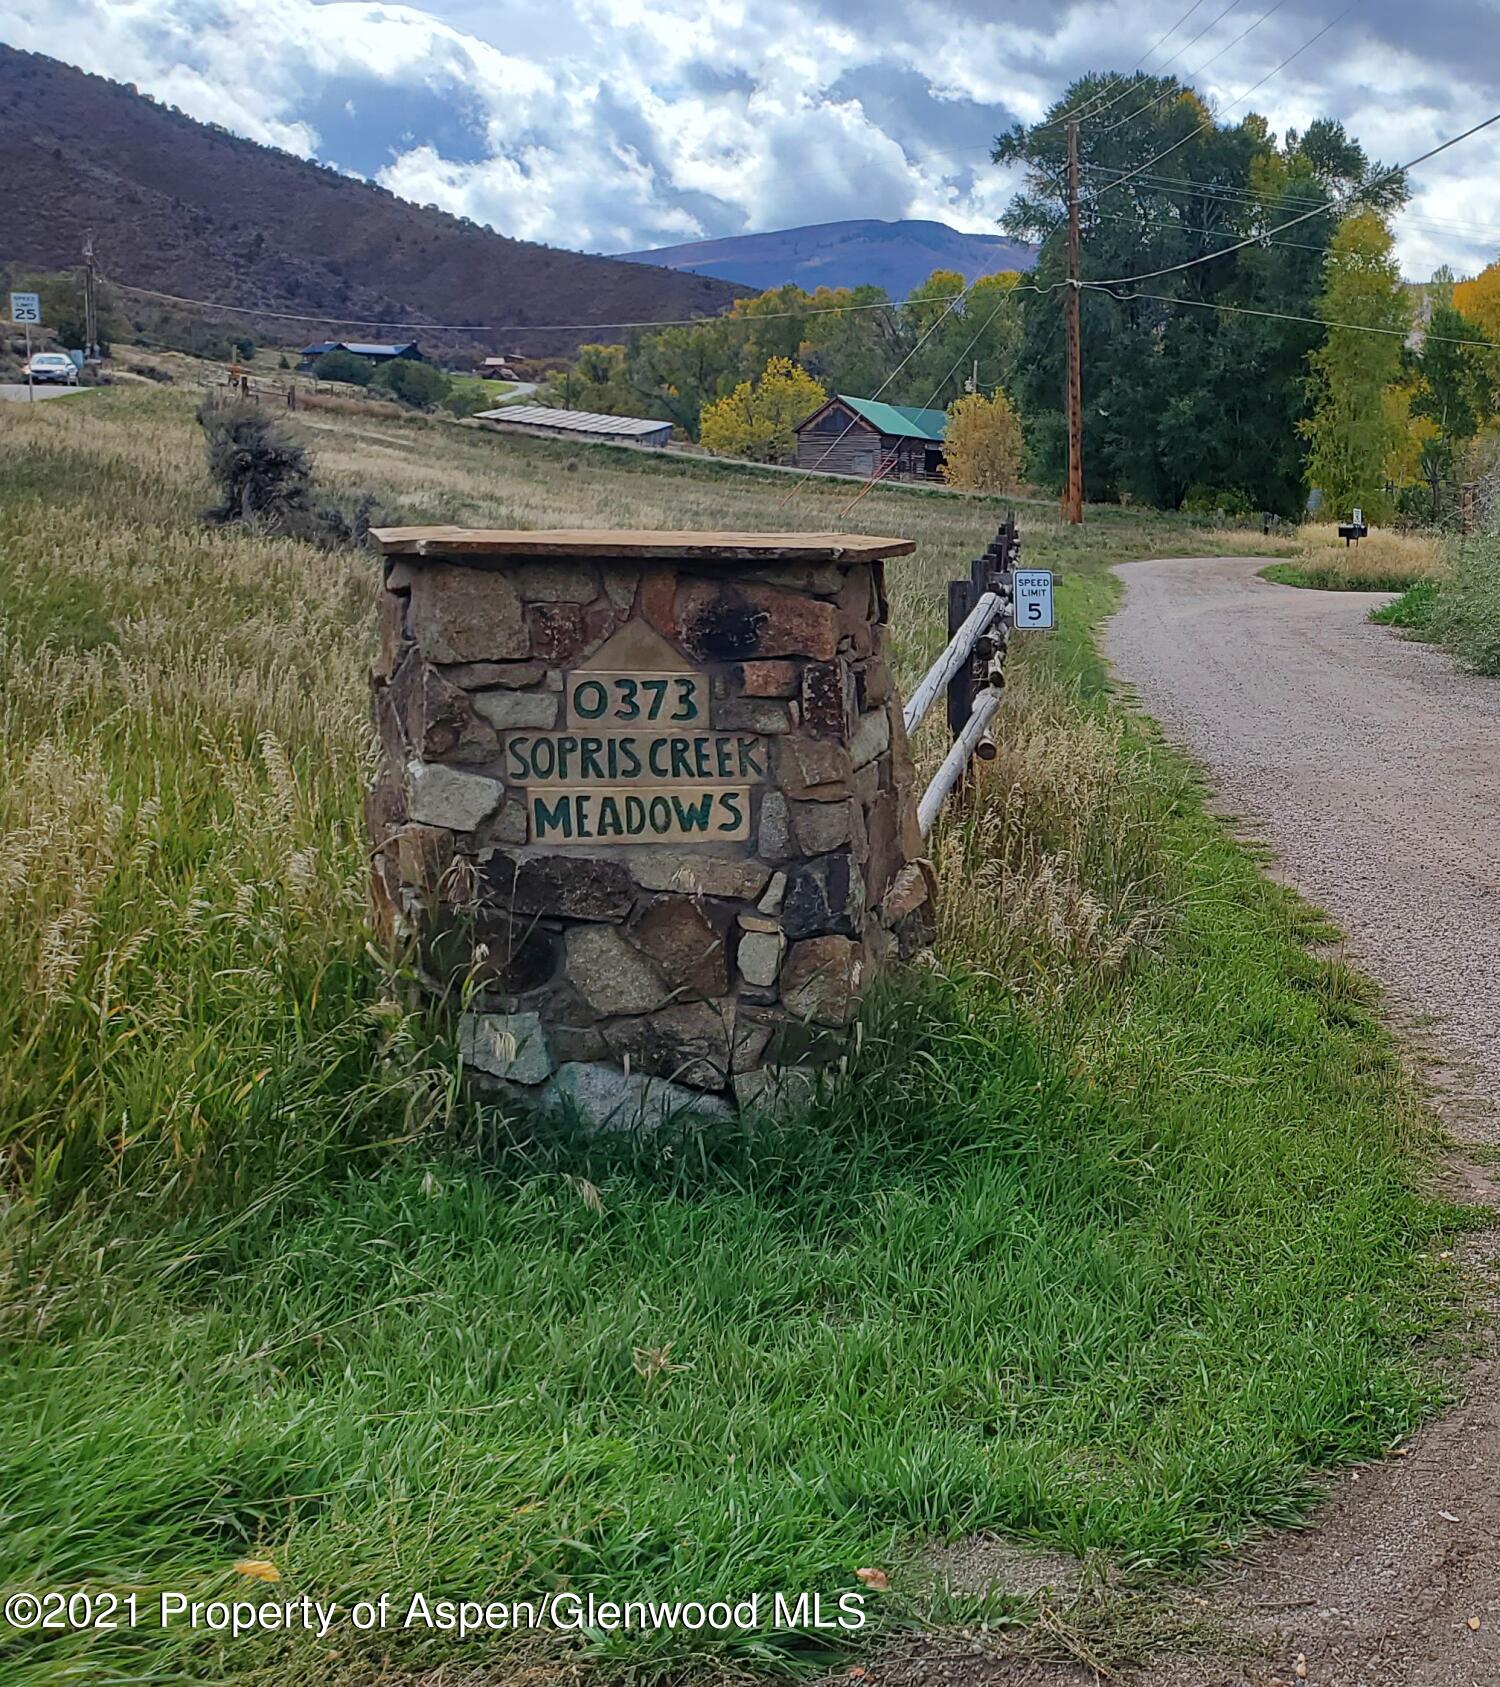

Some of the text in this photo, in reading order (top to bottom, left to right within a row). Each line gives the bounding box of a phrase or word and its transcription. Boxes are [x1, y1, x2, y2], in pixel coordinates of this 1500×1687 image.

[15, 308, 37, 320] 25
[1018, 579, 1050, 587] SPEED
[1021, 589, 1047, 597] LIMIT
[1028, 602, 1042, 621] 5
[508, 736, 763, 780] SOPRIS CREEK
[534, 792, 743, 838] MEADOWS
